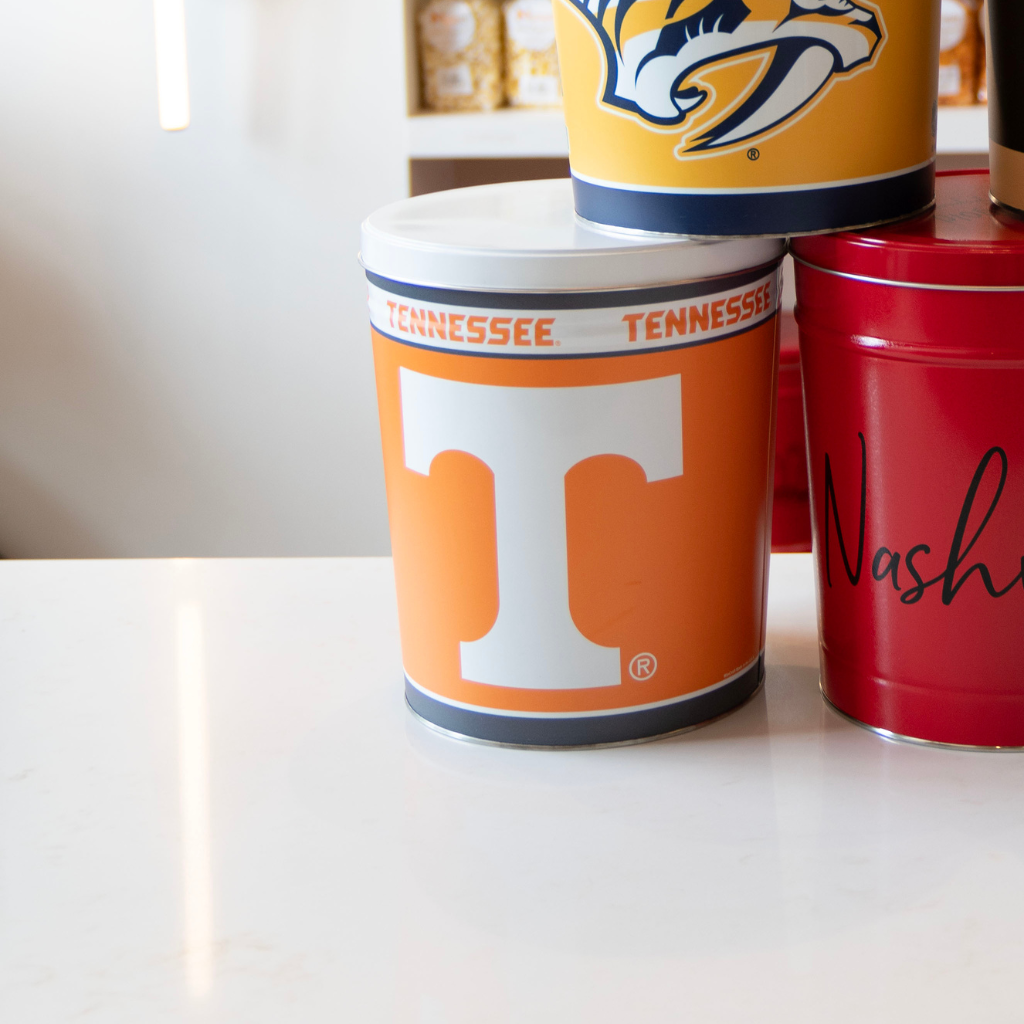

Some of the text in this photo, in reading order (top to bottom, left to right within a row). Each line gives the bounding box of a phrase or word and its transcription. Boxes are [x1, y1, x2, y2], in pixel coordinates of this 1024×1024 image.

[387, 280, 772, 347] TENNESSEE TENNESSEE
[398, 365, 684, 690] T
